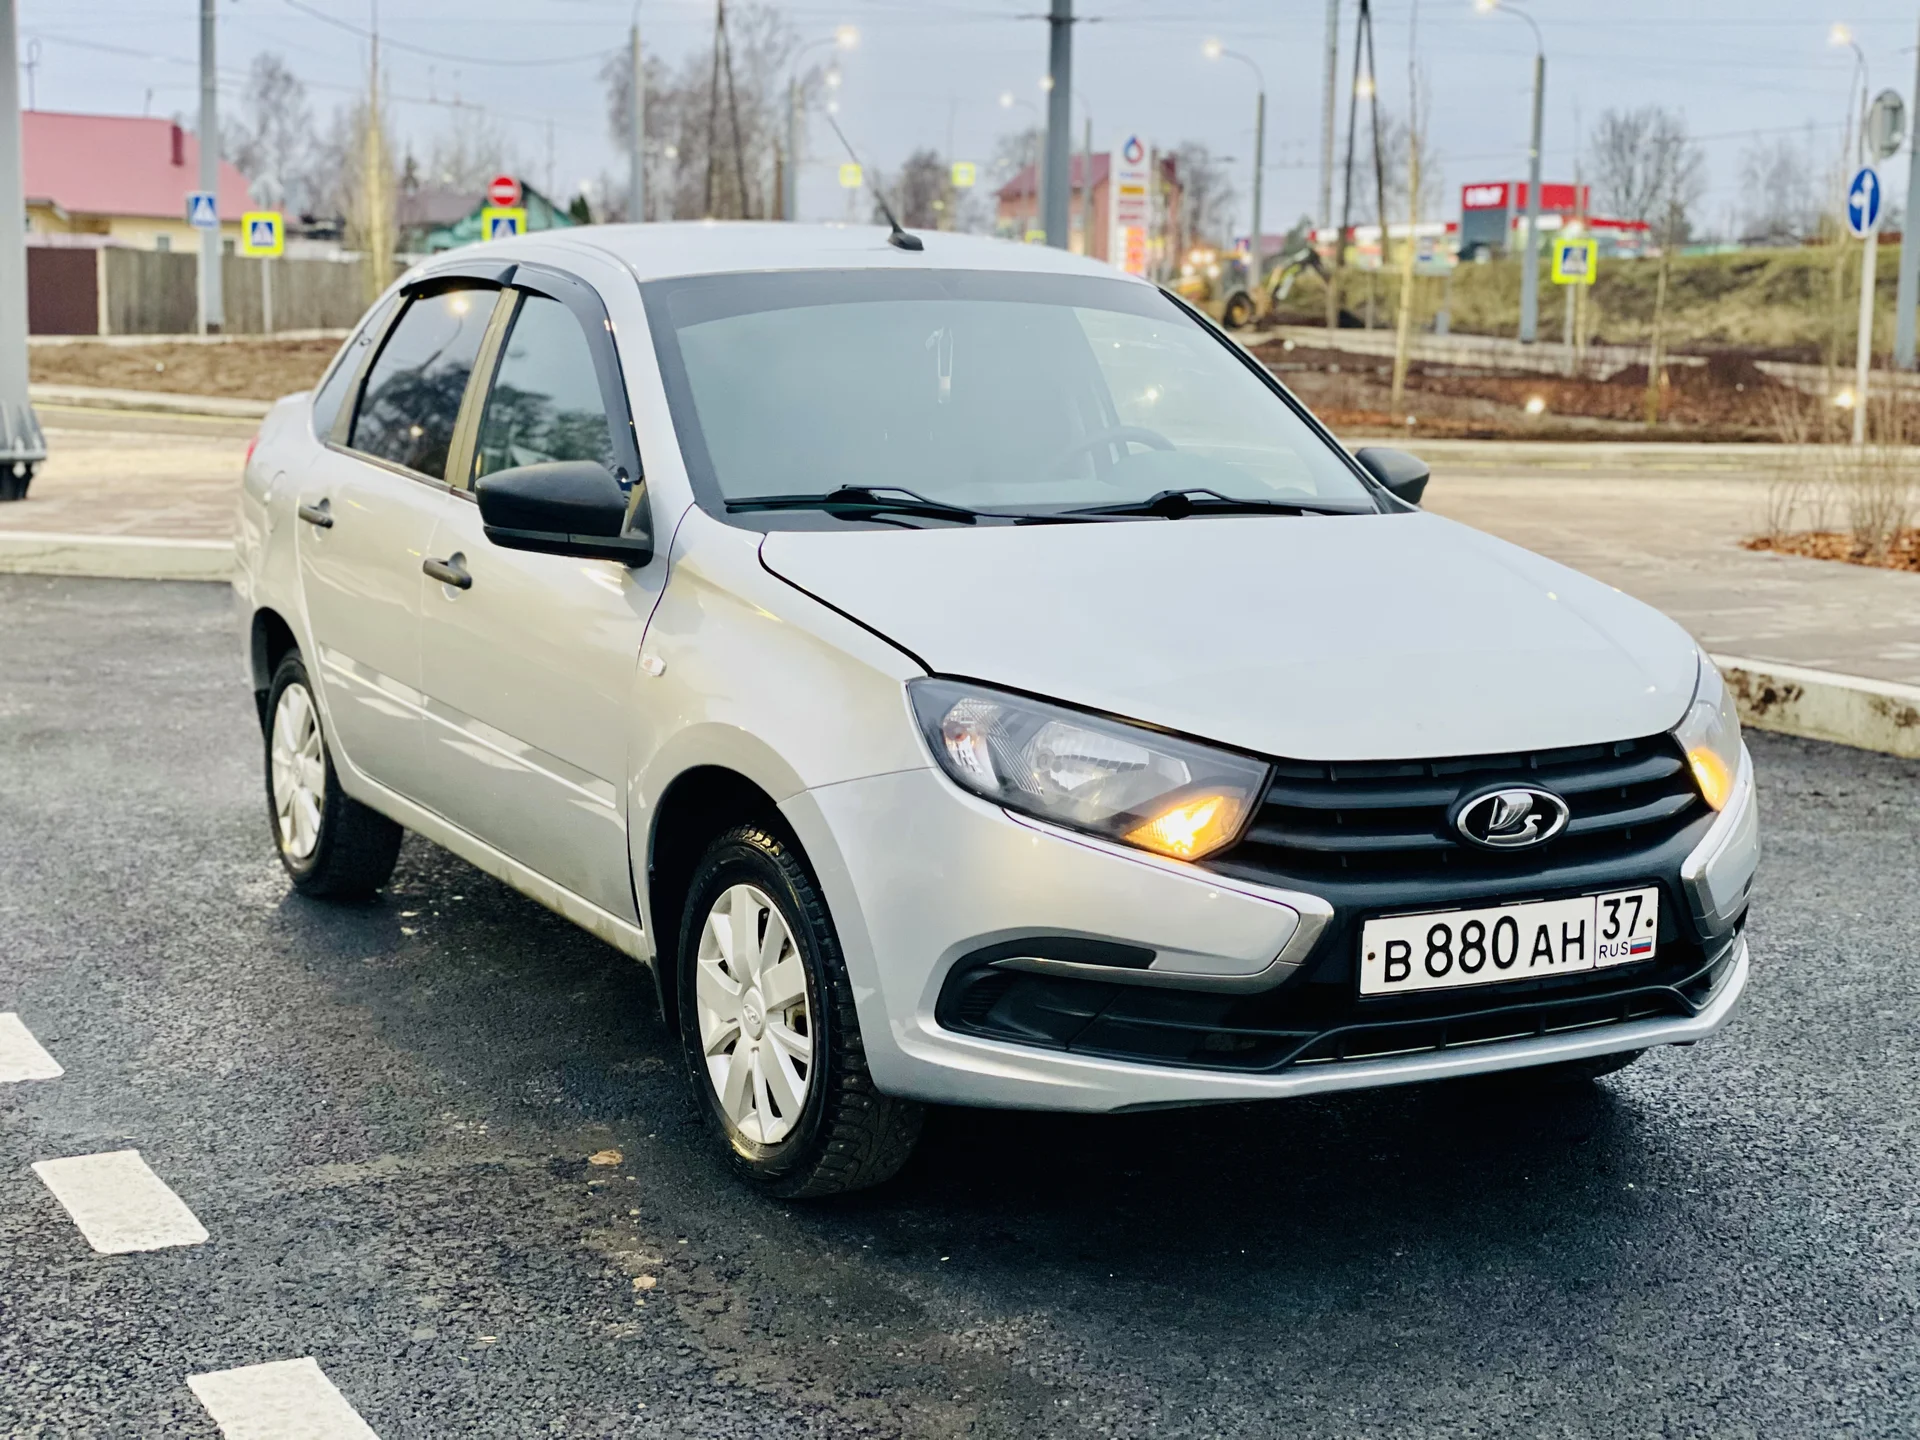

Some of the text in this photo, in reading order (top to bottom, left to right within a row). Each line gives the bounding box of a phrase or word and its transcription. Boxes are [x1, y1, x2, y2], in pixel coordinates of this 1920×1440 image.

[1424, 915, 1520, 979] 880
[1602, 894, 1644, 940] 37
[1598, 940, 1629, 958] RUS
